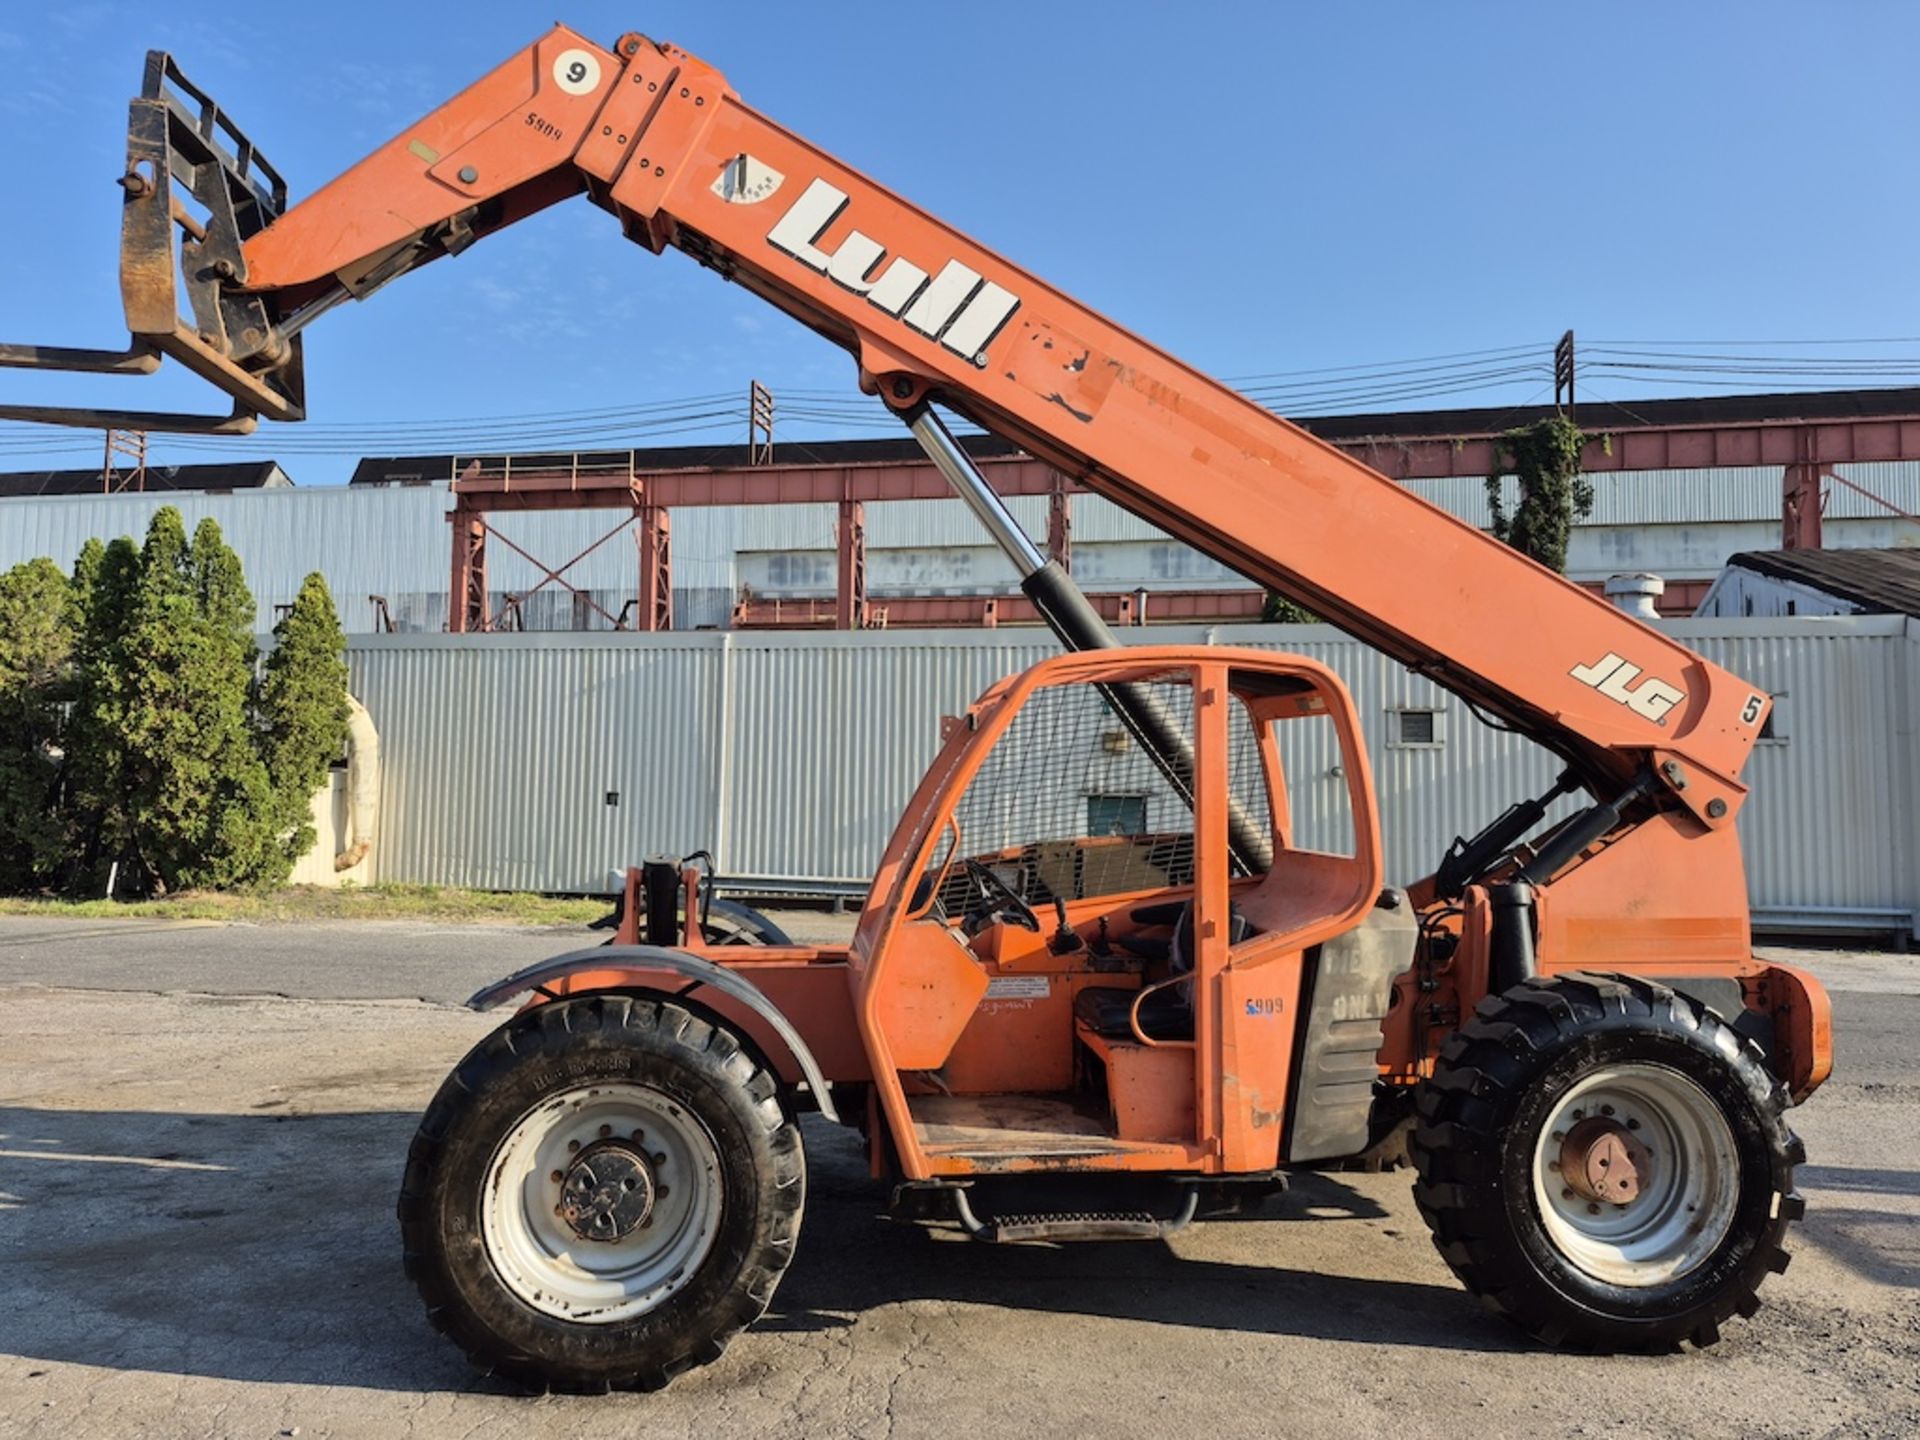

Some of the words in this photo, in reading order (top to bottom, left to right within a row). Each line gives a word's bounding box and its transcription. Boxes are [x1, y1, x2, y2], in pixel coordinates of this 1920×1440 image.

[566, 62, 587, 83] 9
[525, 112, 563, 140] 5909
[766, 176, 1021, 366] Lull
[1567, 650, 1688, 723] JLG
[1743, 696, 1762, 723] 5
